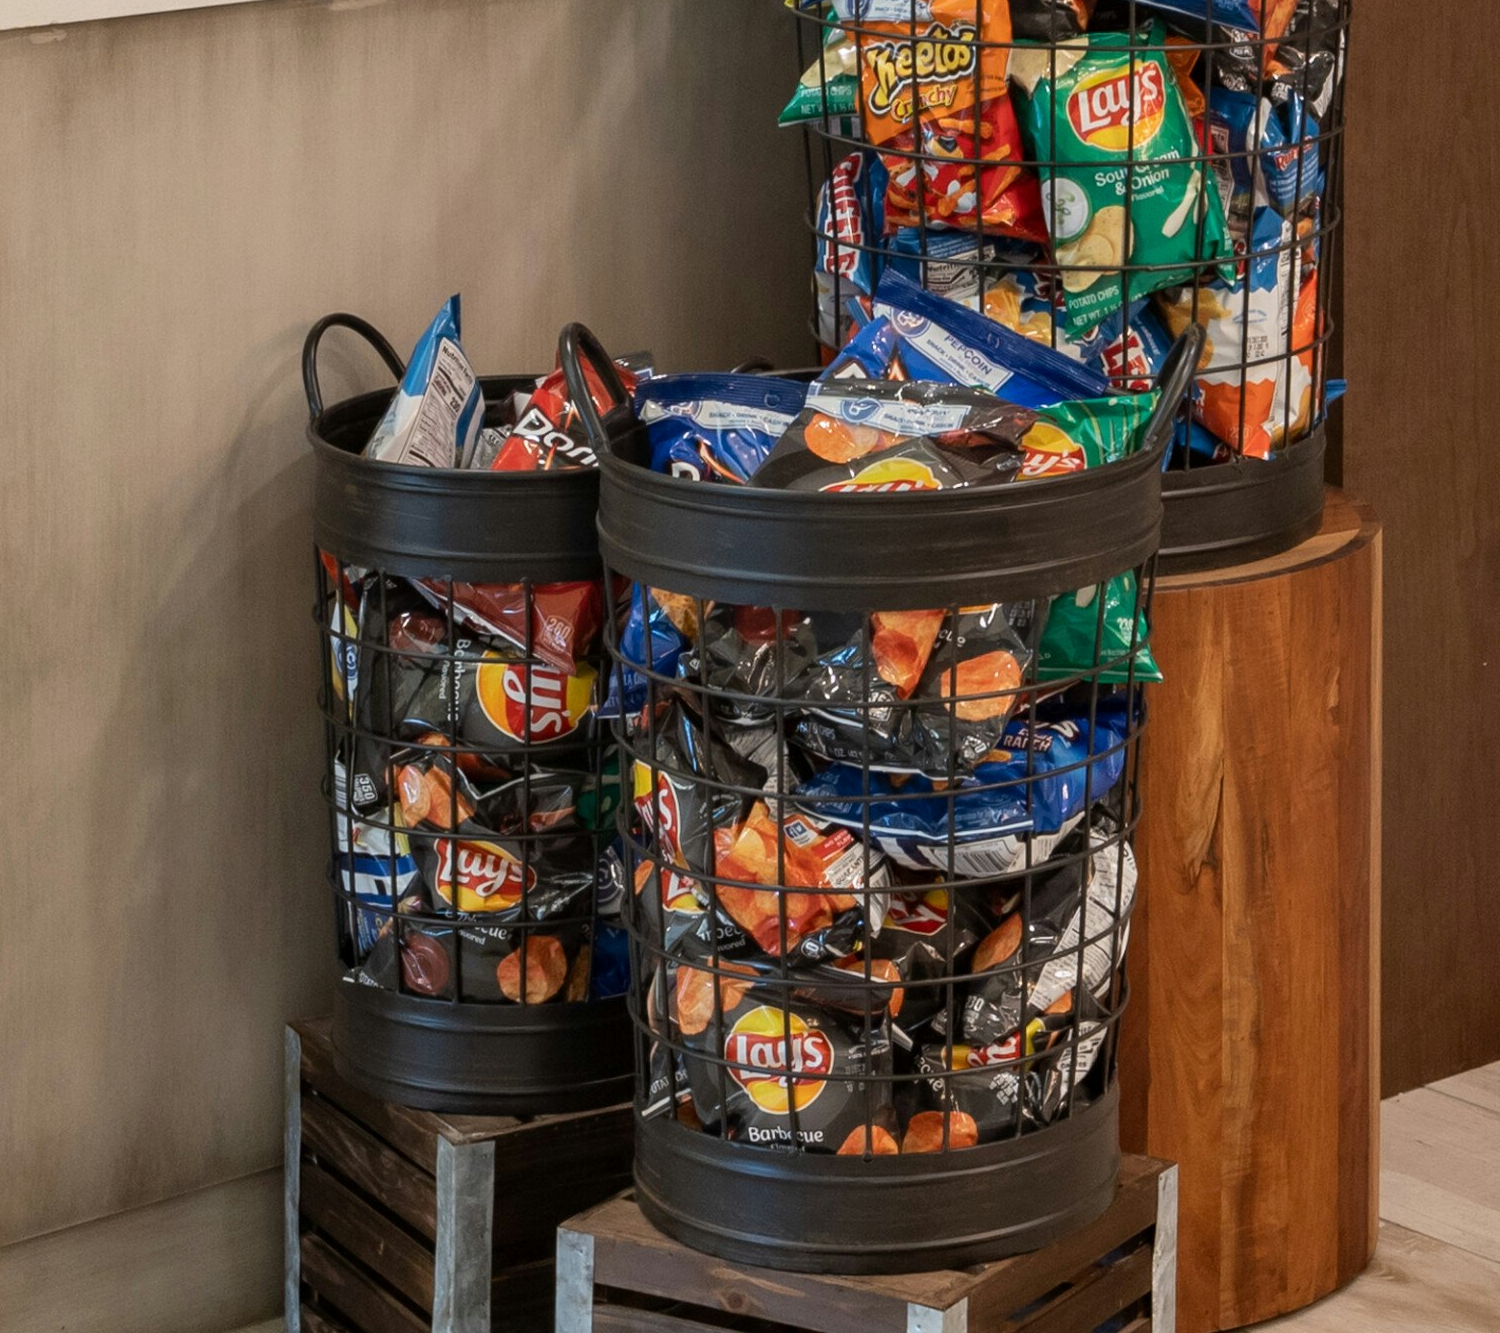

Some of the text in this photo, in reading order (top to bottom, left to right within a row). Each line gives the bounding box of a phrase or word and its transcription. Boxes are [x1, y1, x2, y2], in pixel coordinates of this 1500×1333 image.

[1078, 64, 1159, 133] Lay's
[1068, 285, 1119, 311] POTATO CHIPS
[1073, 313, 1087, 327] NET
[942, 332, 994, 377] PEPCOIN
[548, 617, 571, 637] 260
[735, 1033, 824, 1088] Lay's
